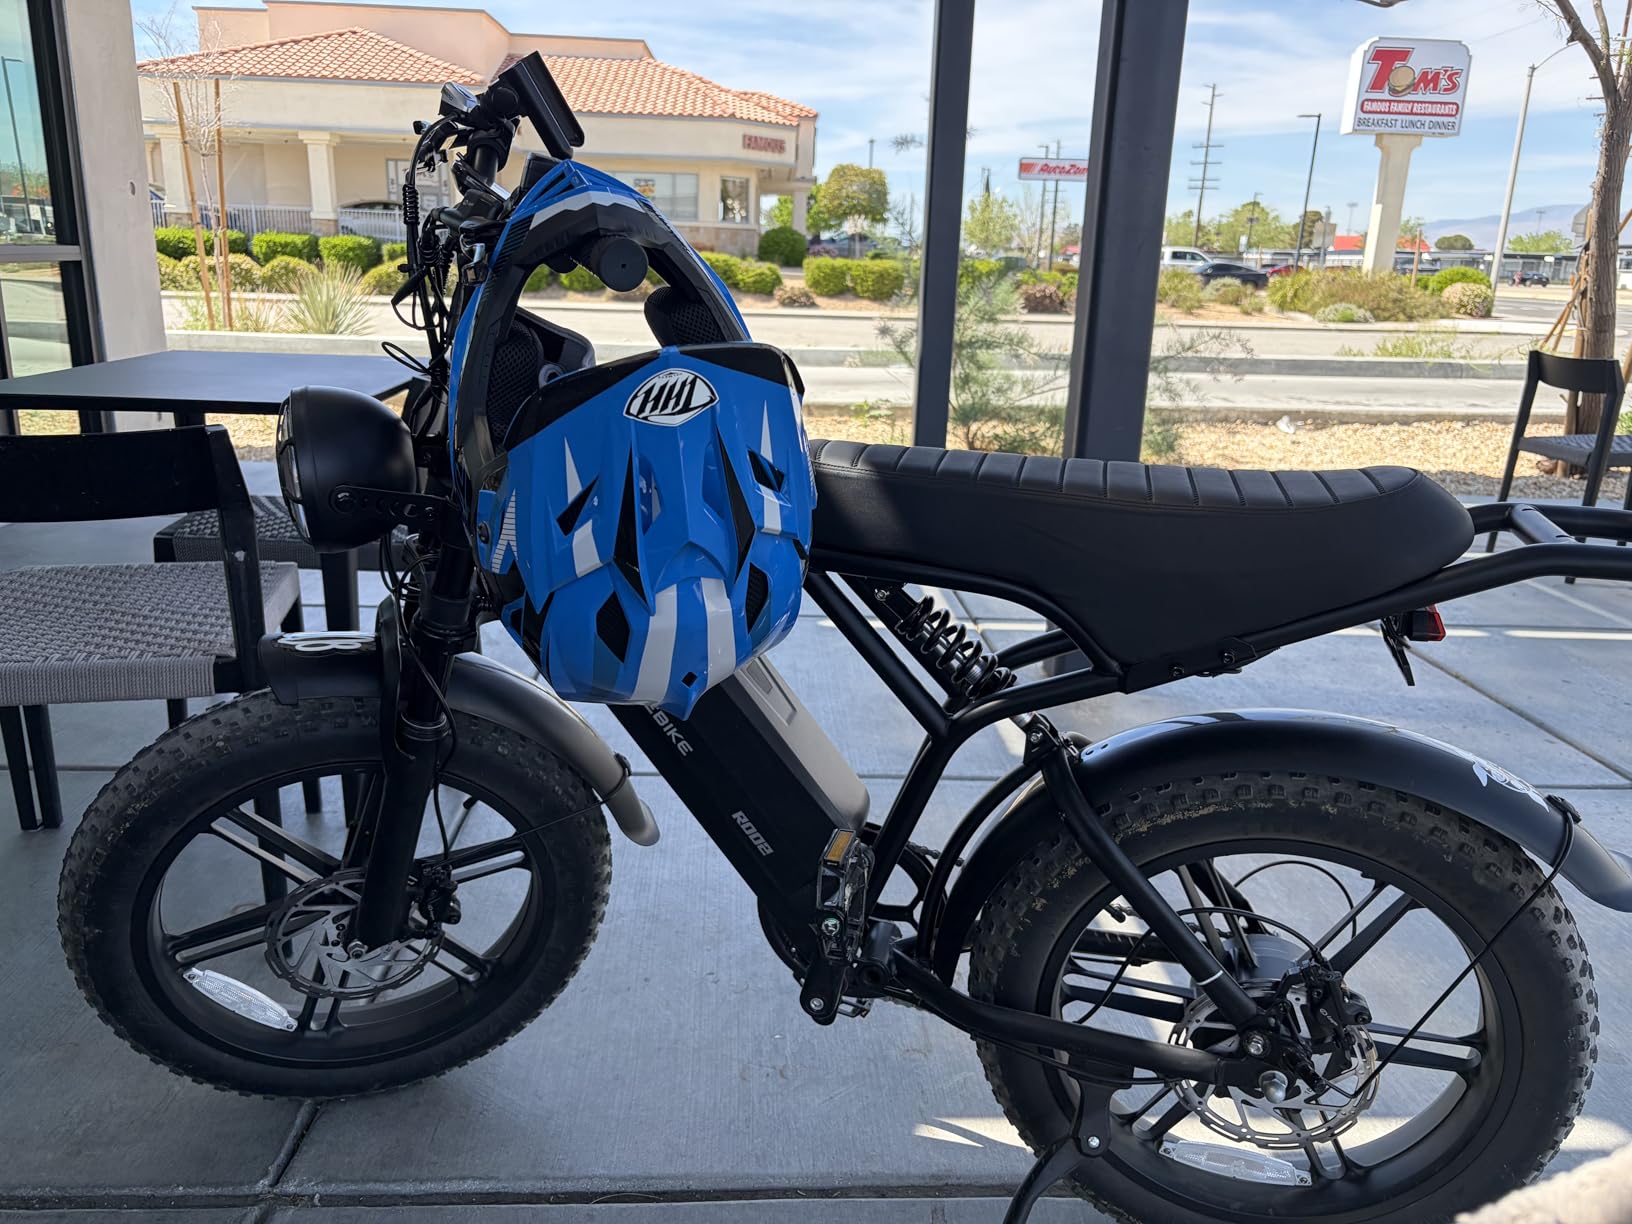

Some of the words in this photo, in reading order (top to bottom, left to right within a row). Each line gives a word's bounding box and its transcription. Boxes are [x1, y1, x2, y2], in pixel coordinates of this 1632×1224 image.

[1363, 101, 1390, 113] FAMOUS
[1390, 101, 1412, 114] FAMILY
[1412, 102, 1457, 116] RESTAURANTS
[1357, 118, 1398, 129] BREAKFAST
[1400, 118, 1426, 130] LUNCH
[1428, 119, 1457, 131] DINNER
[1040, 163, 1088, 175] AutoZon
